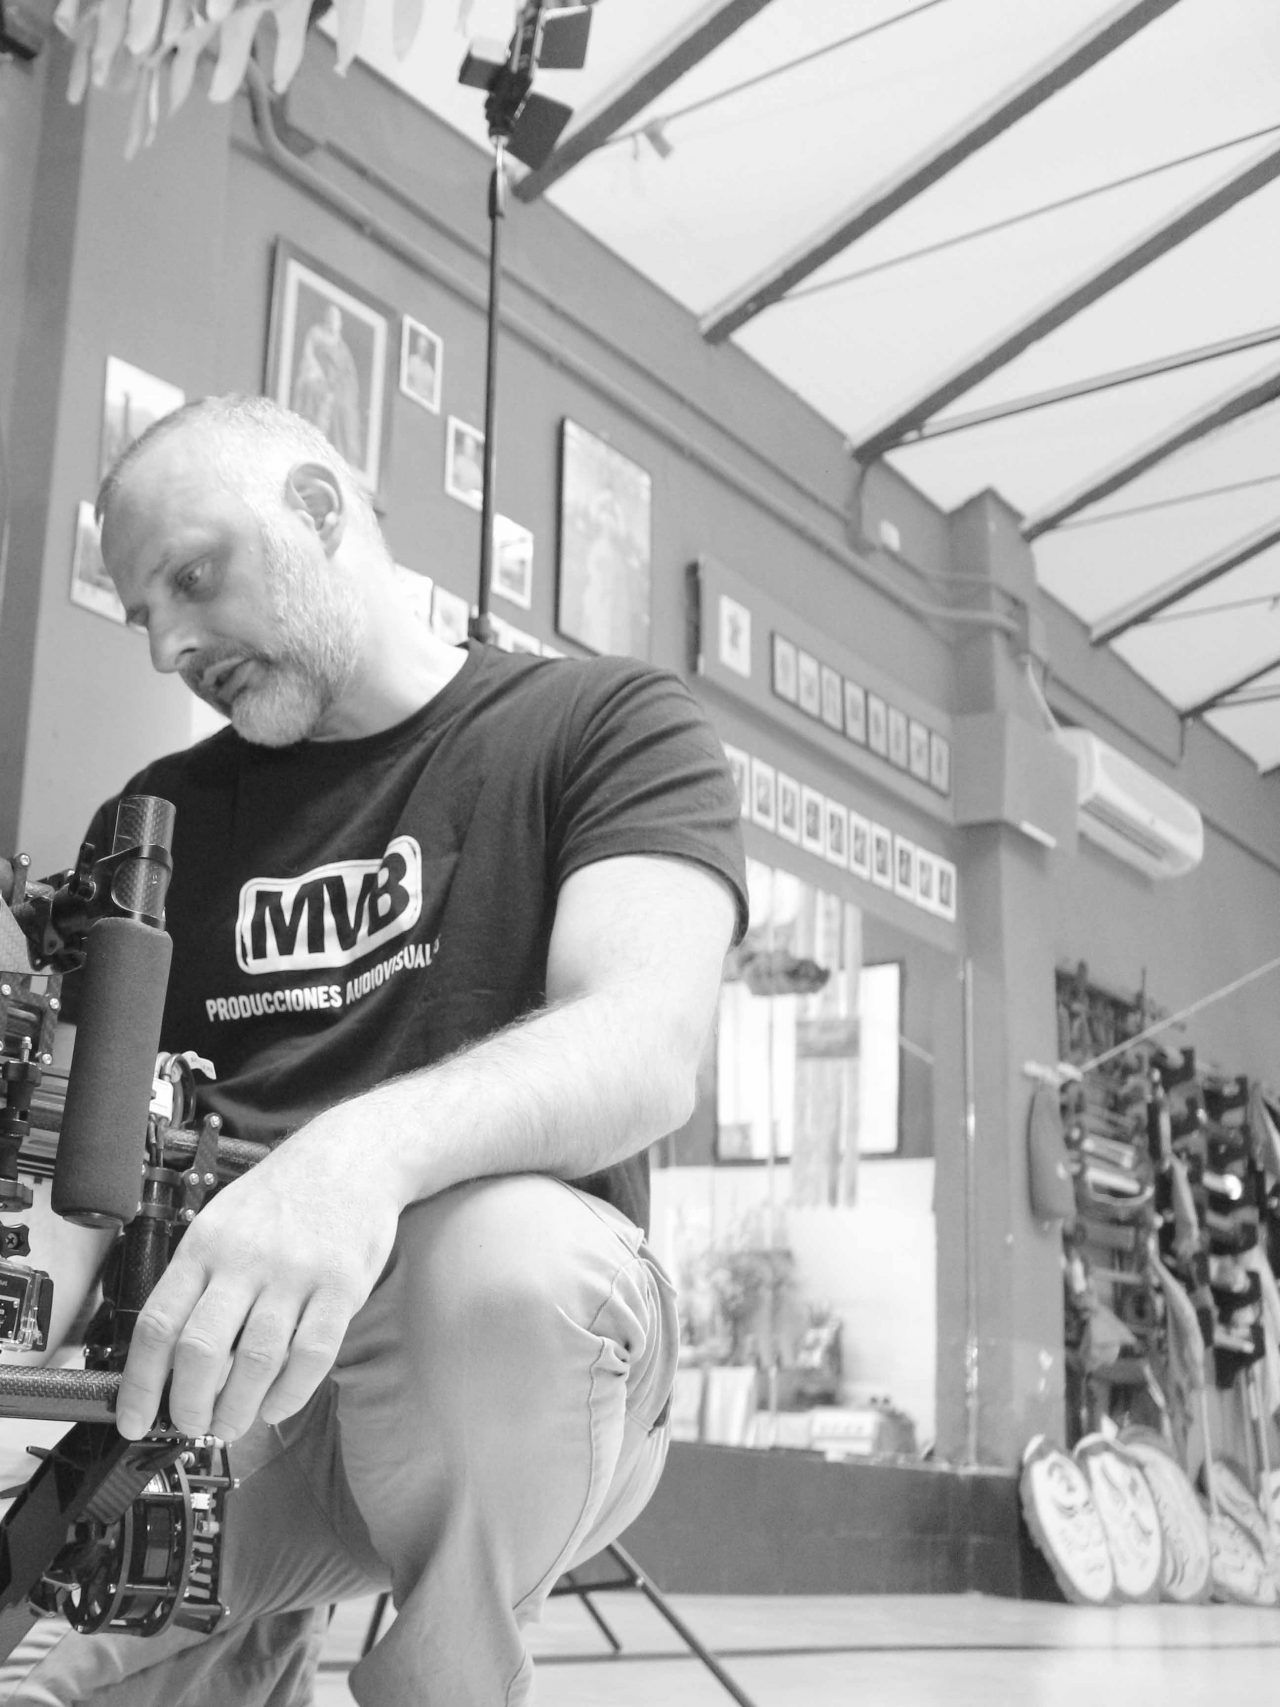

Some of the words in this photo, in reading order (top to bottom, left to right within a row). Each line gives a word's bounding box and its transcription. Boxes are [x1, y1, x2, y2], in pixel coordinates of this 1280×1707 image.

[250, 852, 410, 960] MVB
[205, 985, 343, 1022] PRODUCCIONES
[345, 932, 442, 1005] AUDIOVISUAL
